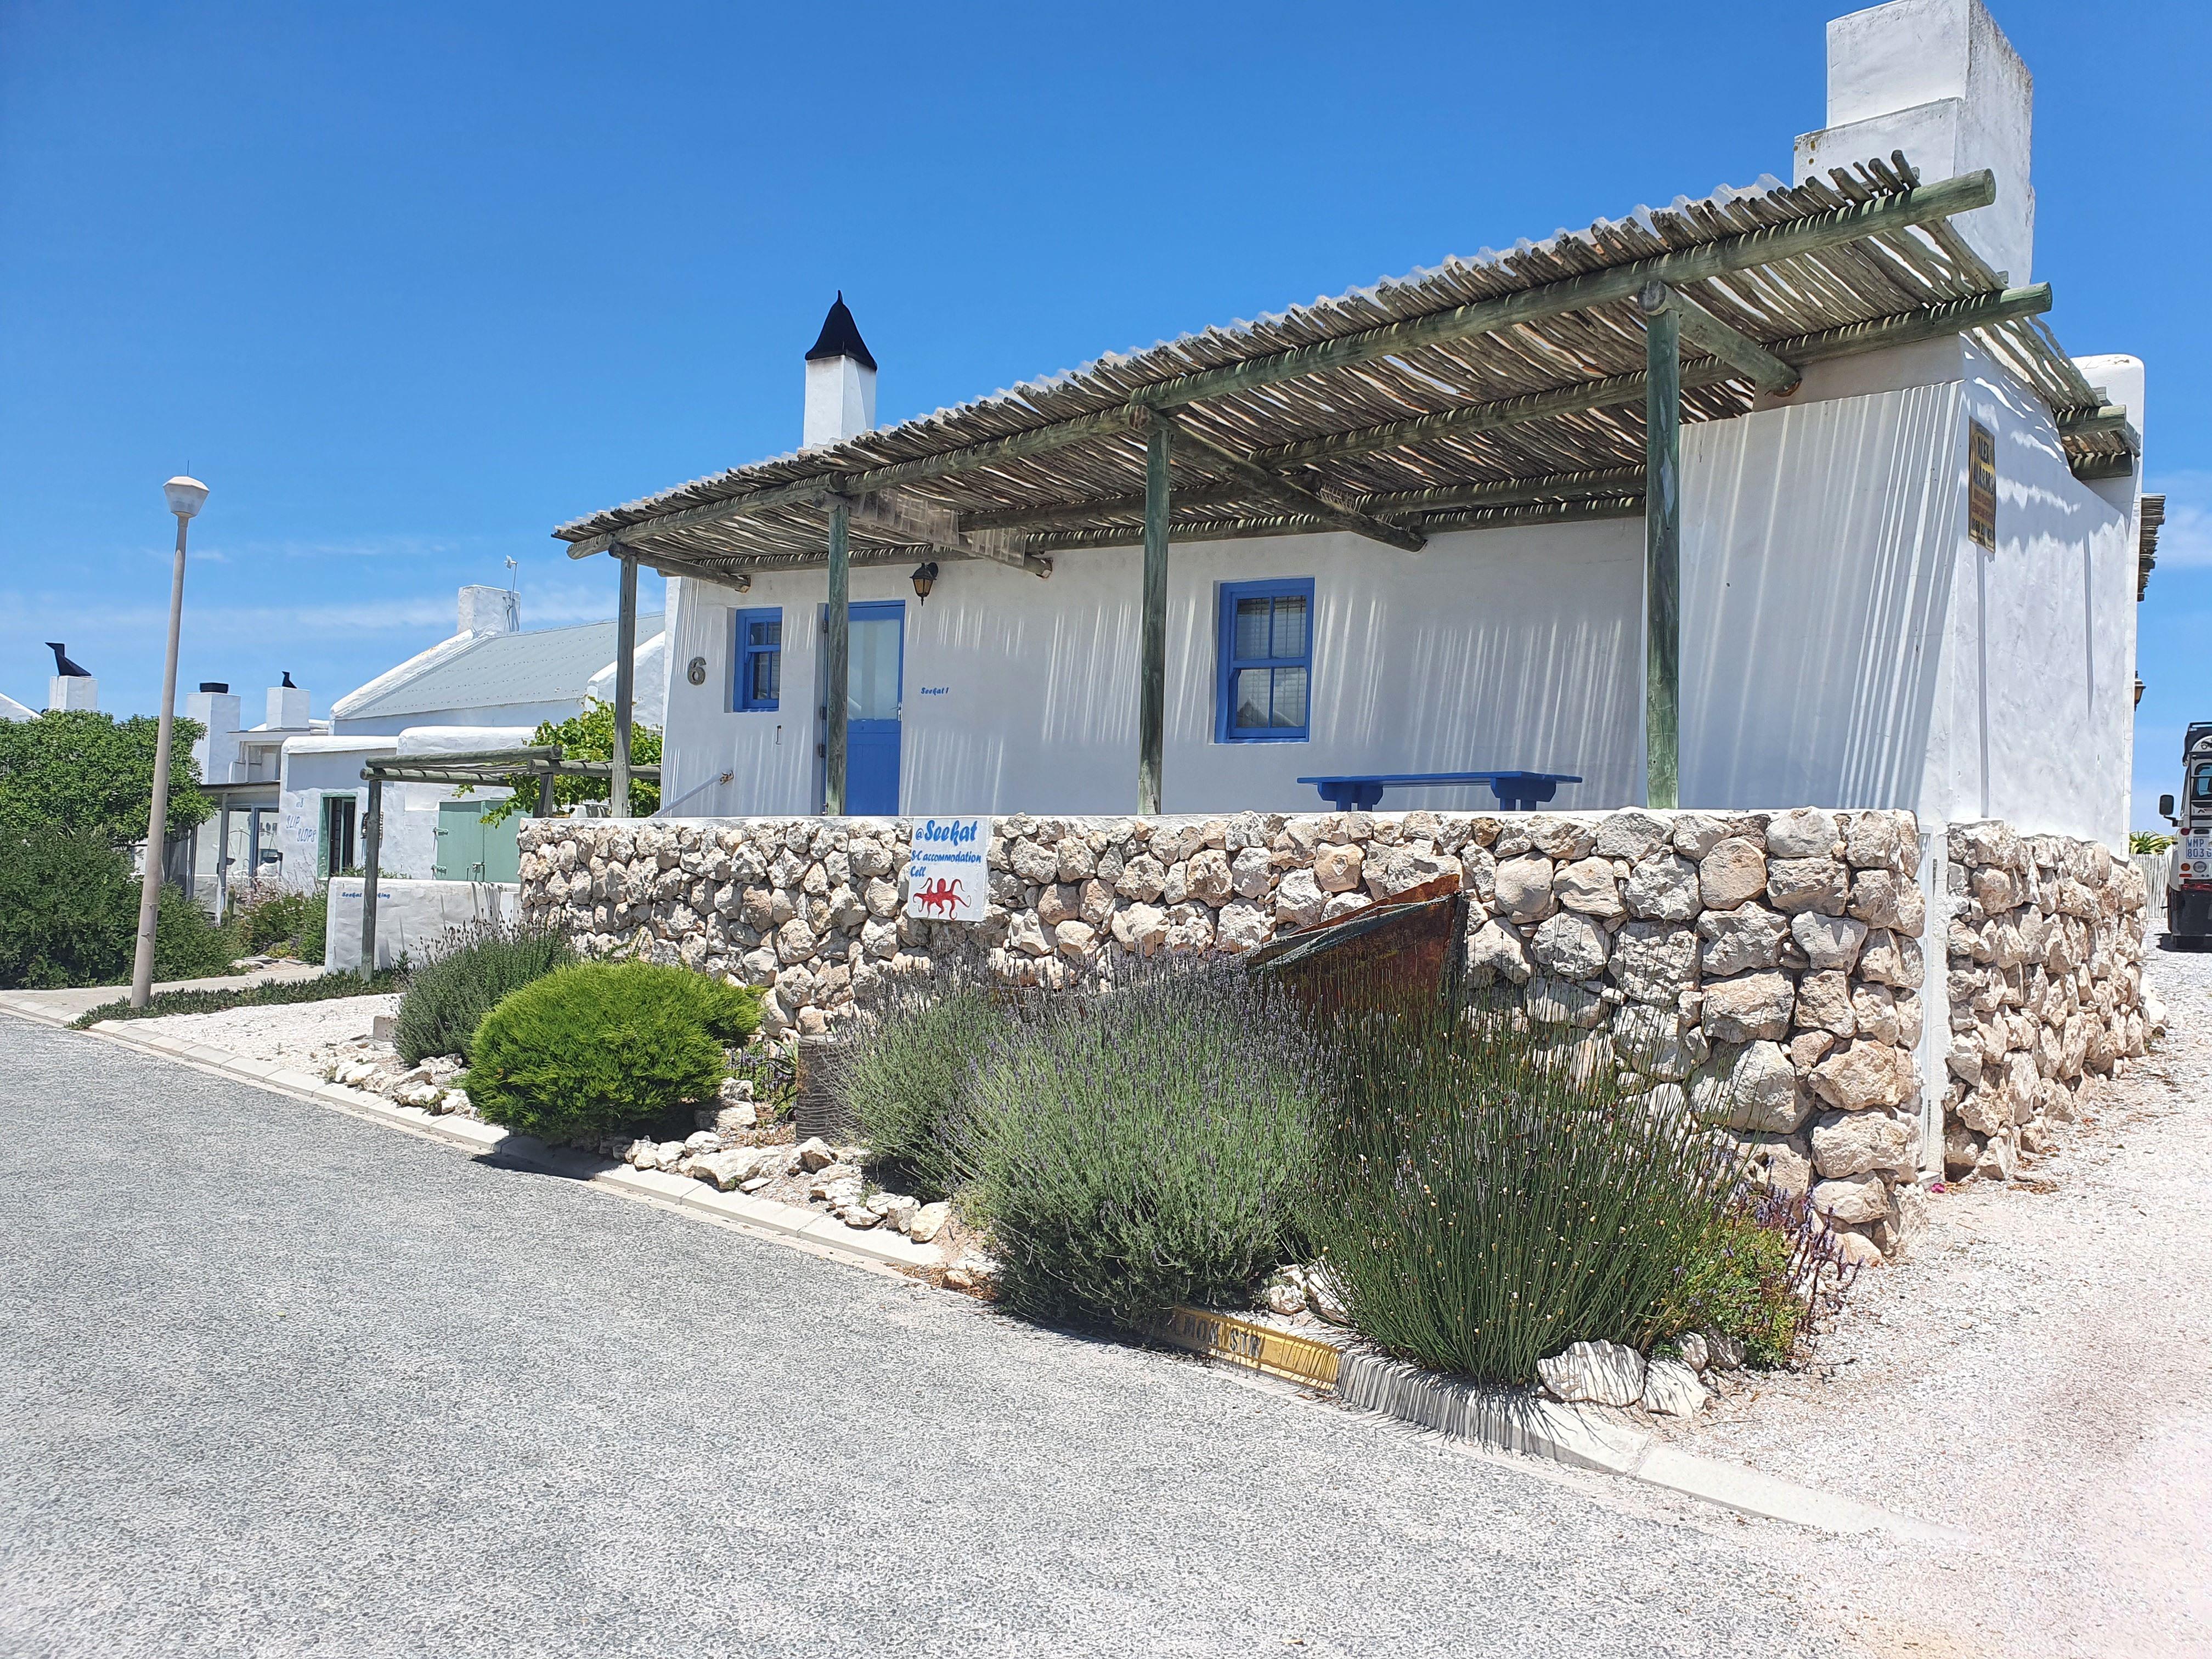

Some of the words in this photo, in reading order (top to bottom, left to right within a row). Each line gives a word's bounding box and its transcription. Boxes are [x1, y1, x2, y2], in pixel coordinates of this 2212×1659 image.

[687, 657, 706, 685] 6
[286, 815, 300, 828] SLIP
[297, 828, 317, 842] SLOPS
[2187, 838, 2204, 848] WMP
[923, 851, 981, 863] accommodation
[910, 866, 926, 877] Cell
[1229, 1327, 1260, 1359] STR
